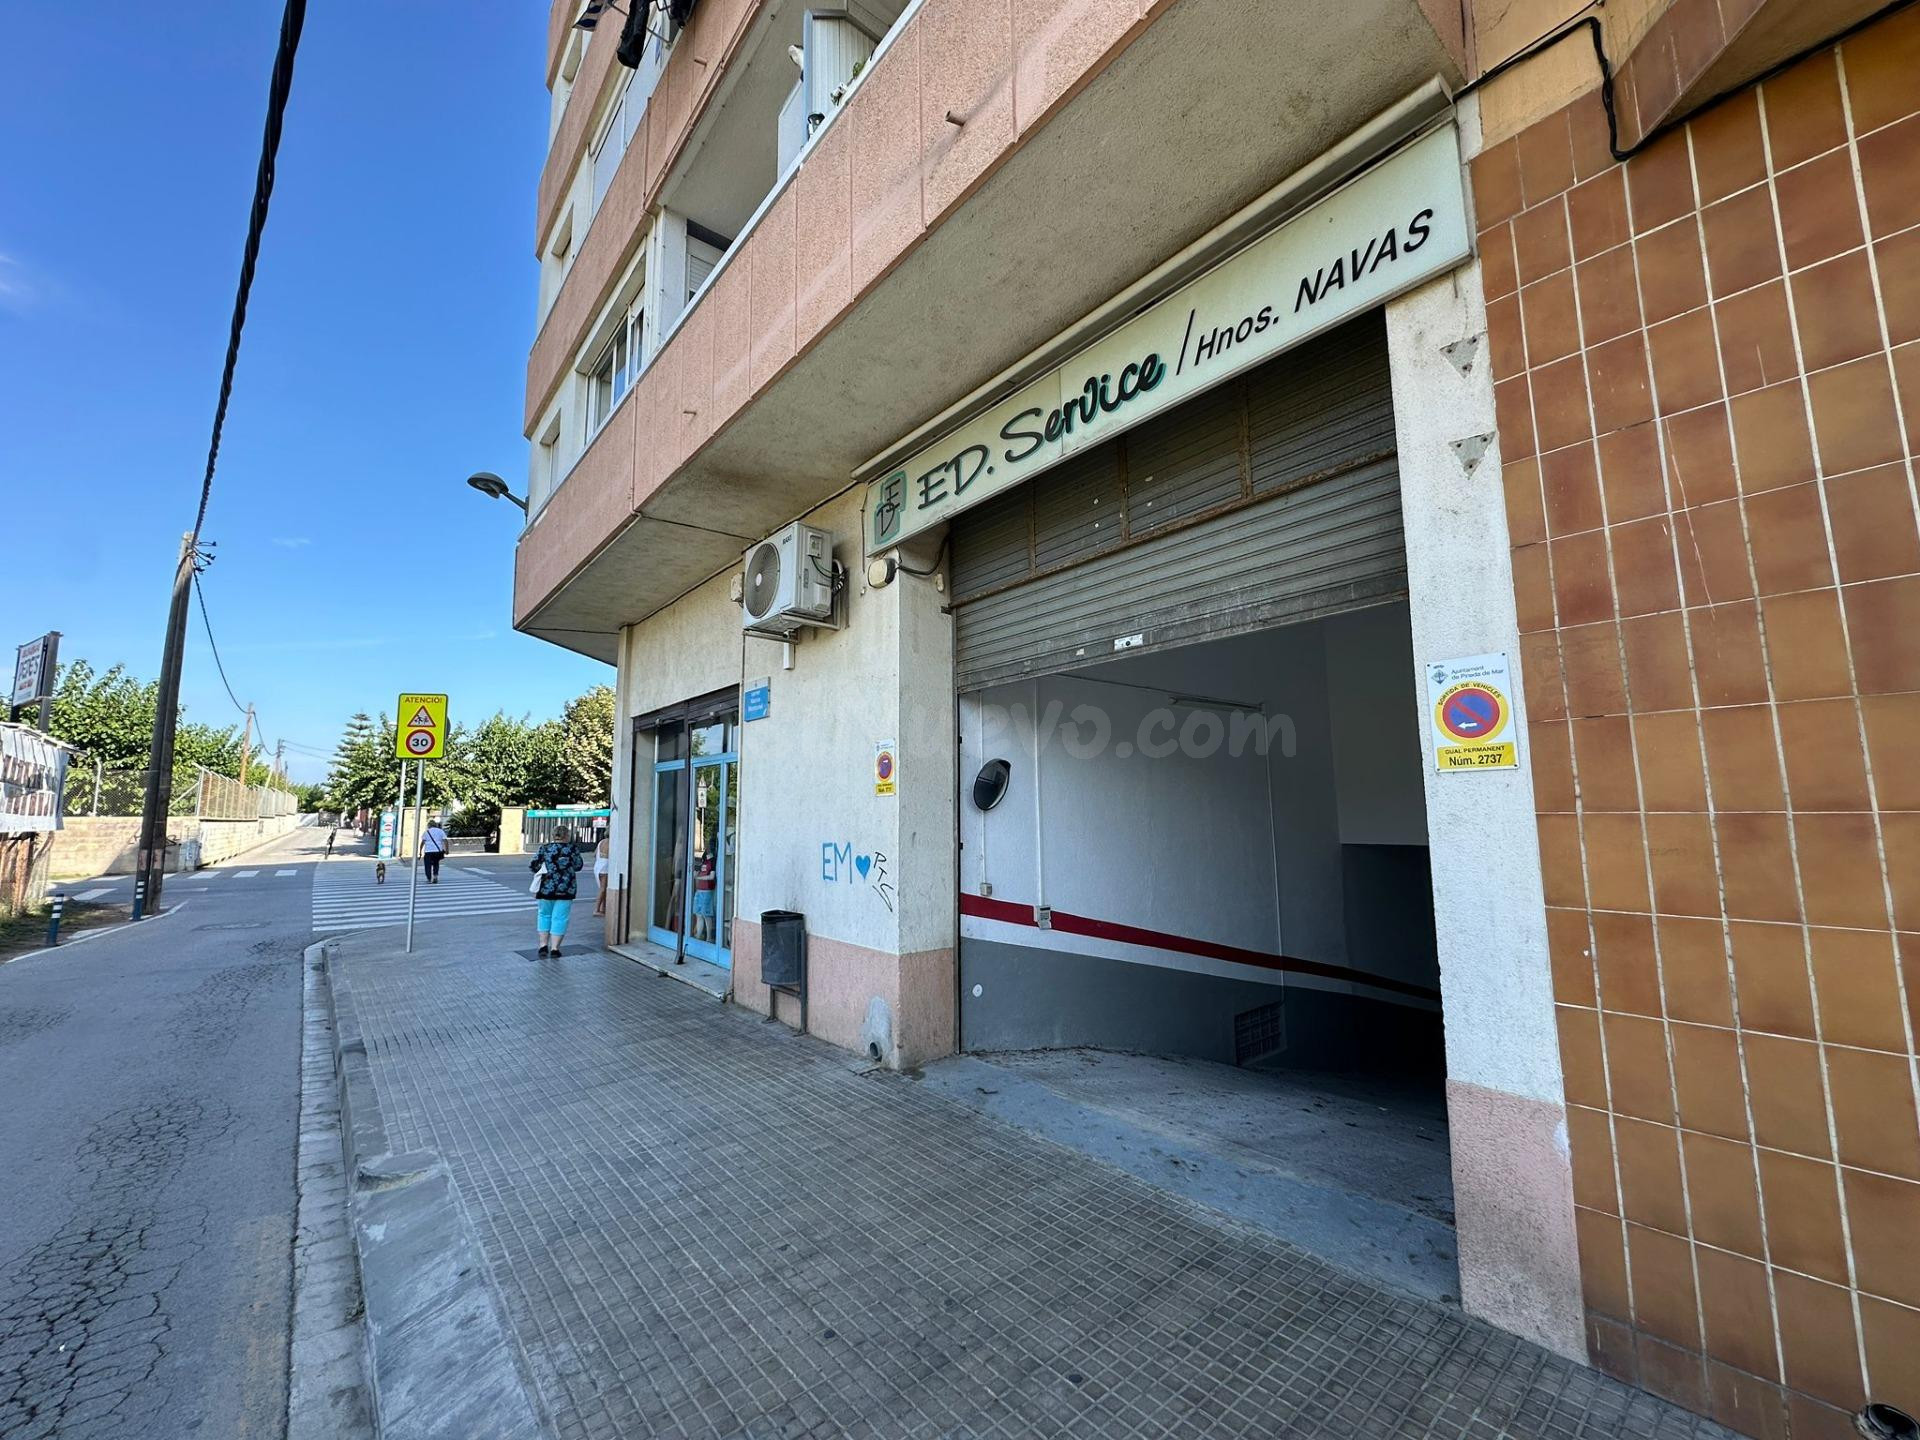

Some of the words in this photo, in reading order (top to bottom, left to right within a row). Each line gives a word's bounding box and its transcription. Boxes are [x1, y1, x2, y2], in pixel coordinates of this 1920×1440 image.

[917, 444, 995, 511] ED.
[998, 350, 1167, 464] Service
[1193, 304, 1281, 367] Hnos.
[1293, 207, 1436, 314] NAVAS
[1451, 665, 1484, 674] Ajuntament
[1437, 686, 1460, 705] SORTIDA
[1473, 683, 1501, 698] VEHICLES
[412, 738, 428, 747] 30
[1463, 745, 1505, 754] PERMANENT
[1449, 755, 1475, 766] Núm.
[1478, 754, 1502, 765] 2737
[822, 841, 853, 885] EM
